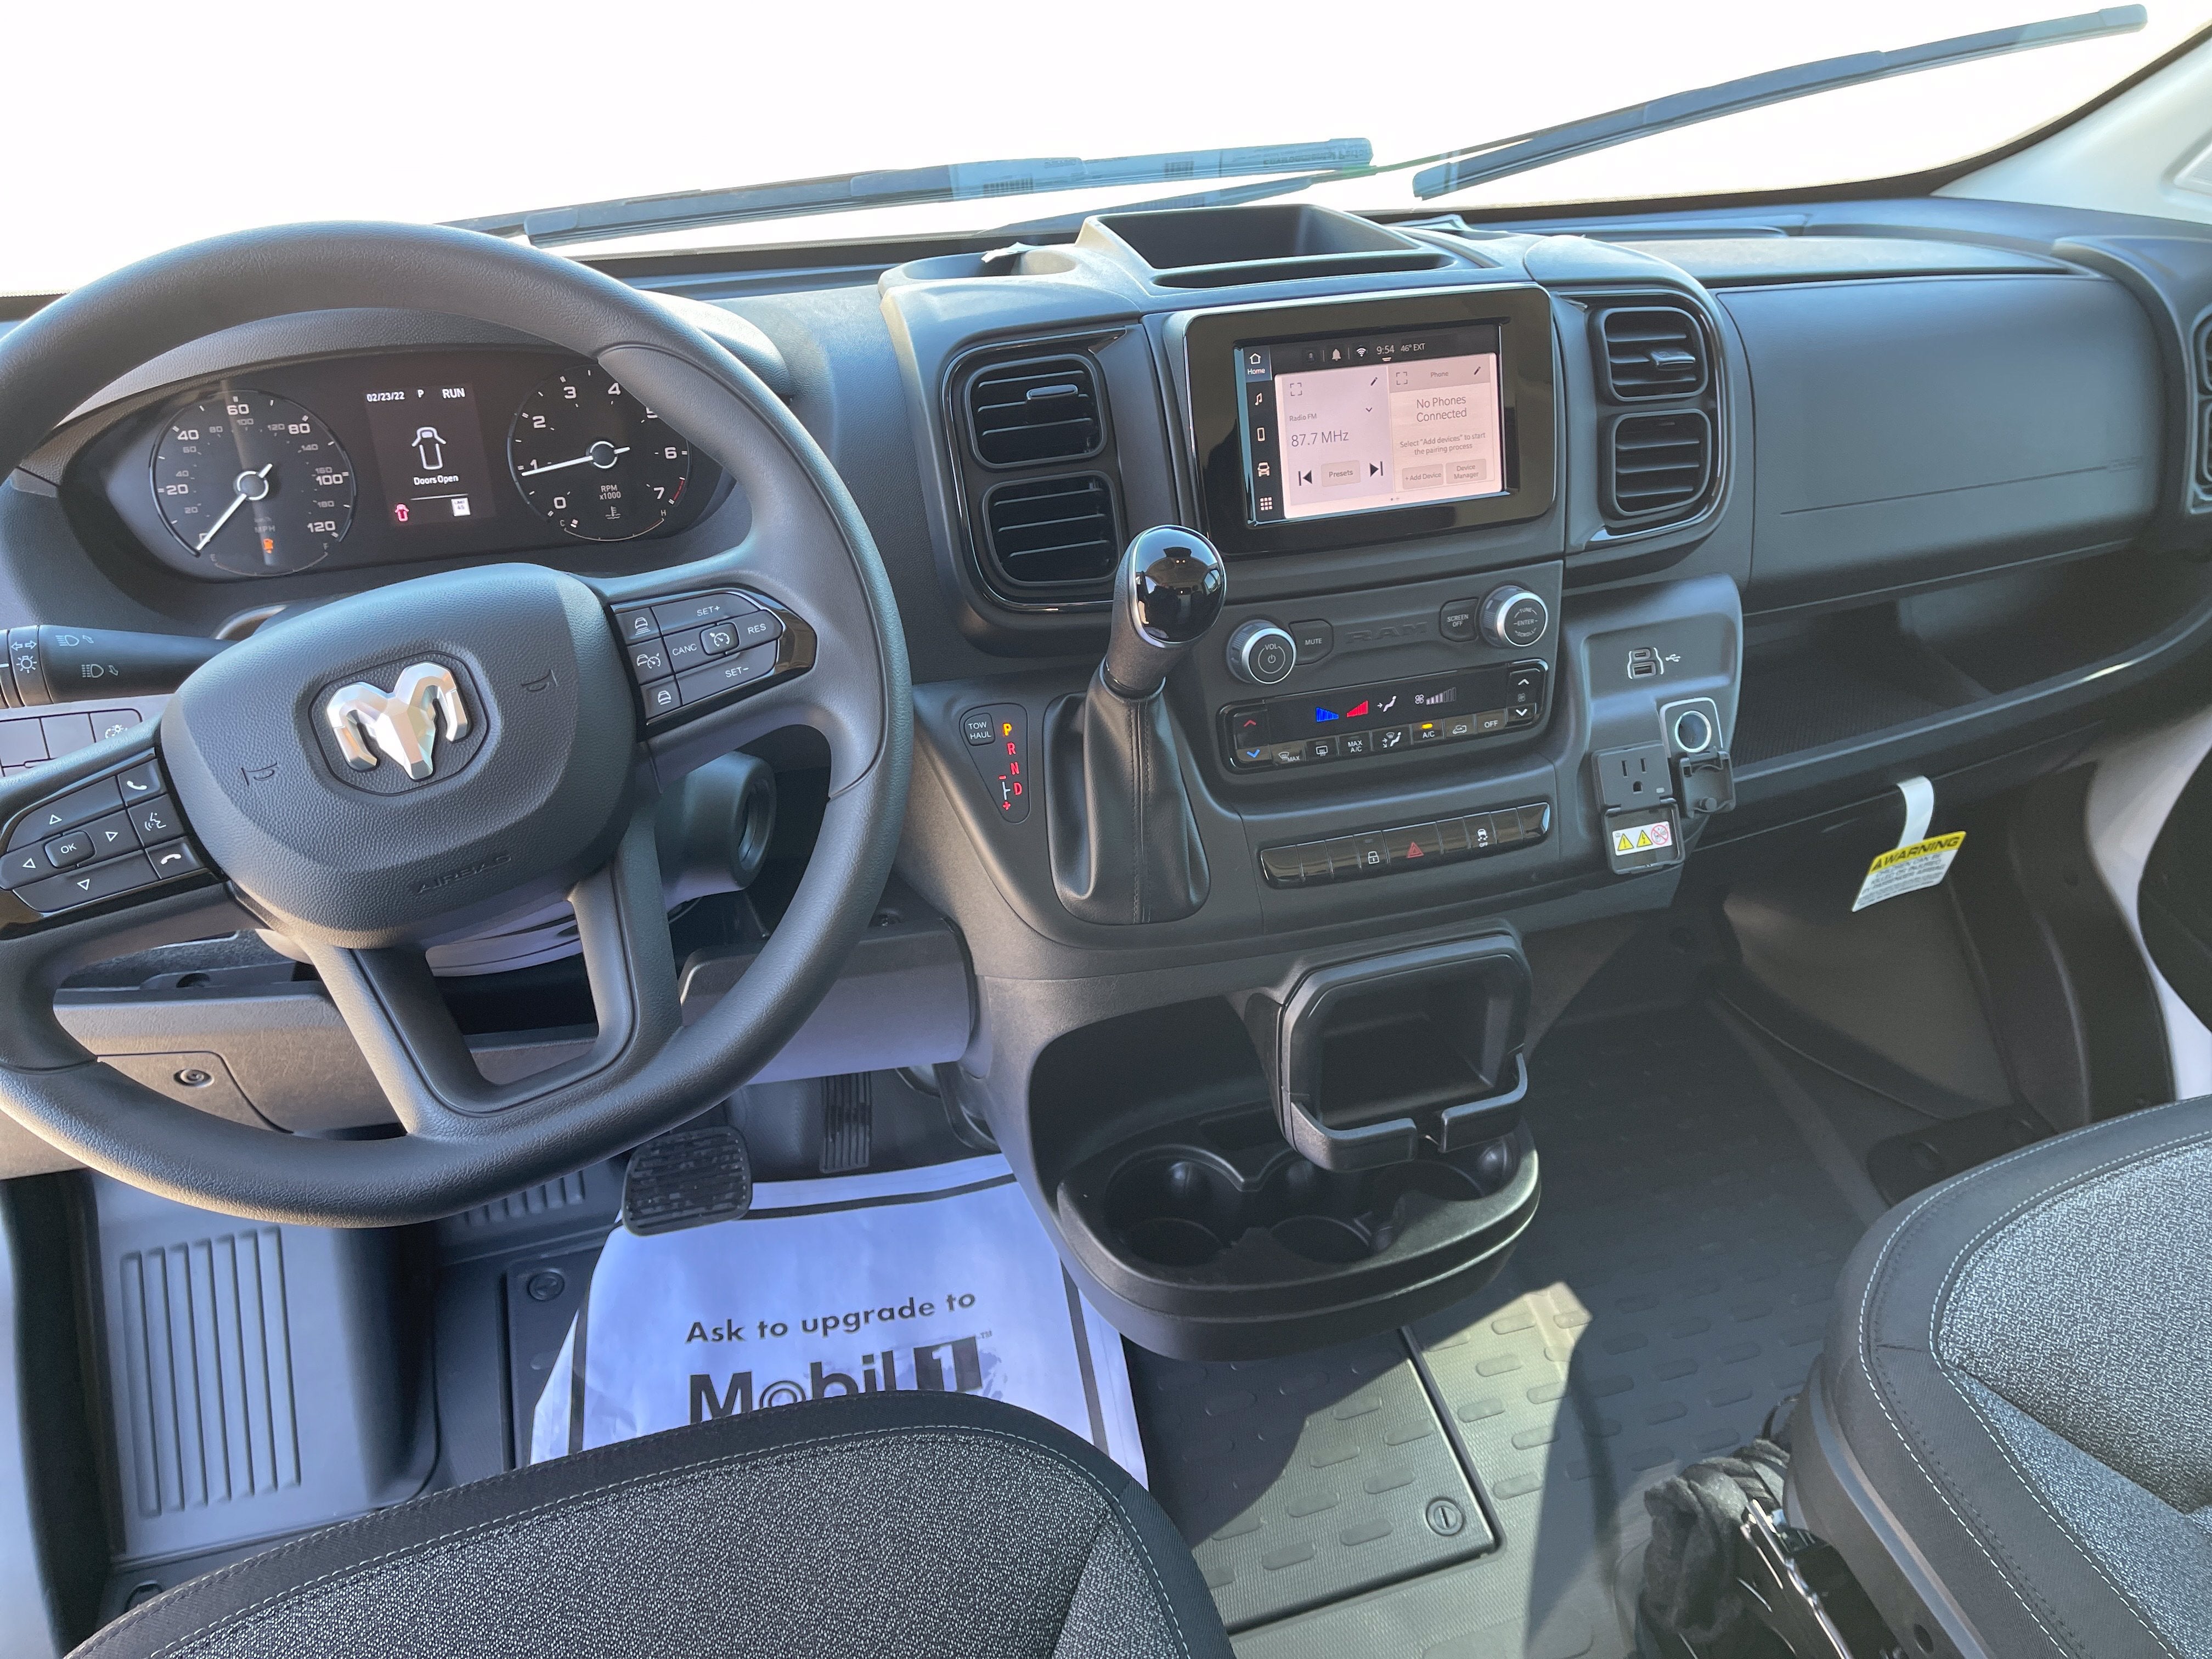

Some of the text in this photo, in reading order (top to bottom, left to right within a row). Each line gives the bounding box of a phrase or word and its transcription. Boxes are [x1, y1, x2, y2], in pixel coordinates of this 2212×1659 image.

[1376, 345, 1395, 354] 9:54
[1413, 343, 1425, 351] EXT
[366, 388, 465, 402] 02/23/22 P RUN
[563, 386, 576, 399] 3
[608, 383, 621, 395] 4
[1417, 396, 1466, 409] No Phones
[227, 404, 249, 415] 60
[1417, 408, 1467, 422] Connected
[532, 415, 546, 428] 2
[288, 423, 311, 435] 80
[177, 430, 199, 441] 40
[1291, 430, 1349, 447] 87.7 MHz
[301, 443, 318, 452] 140
[665, 447, 677, 459] 6
[1426, 447, 1448, 456] pairing
[1449, 443, 1472, 452] process
[530, 459, 538, 470] 1
[316, 473, 343, 486] 100
[414, 475, 459, 485] Doors Open
[1329, 470, 1353, 478] Presets
[1454, 472, 1479, 480] Manager
[166, 483, 189, 495] 20
[653, 487, 664, 499] 7
[554, 497, 566, 509] 0
[254, 525, 275, 533] MPH
[307, 521, 336, 533] 120
[1447, 614, 1469, 622] SCREEN
[747, 623, 766, 635] RES
[1345, 622, 1426, 645] RAM
[672, 643, 697, 656] CANC
[968, 721, 987, 730] TOW
[1003, 723, 1012, 736] P
[1484, 720, 1498, 728] OFF
[970, 731, 991, 740] HAUL
[1007, 742, 1016, 755] R
[1011, 761, 1020, 775] N
[1014, 782, 1022, 795] D
[60, 843, 77, 854] OK
[1884, 836, 1960, 866] WARNING
[686, 1293, 975, 1344] Ask to upgrade to
